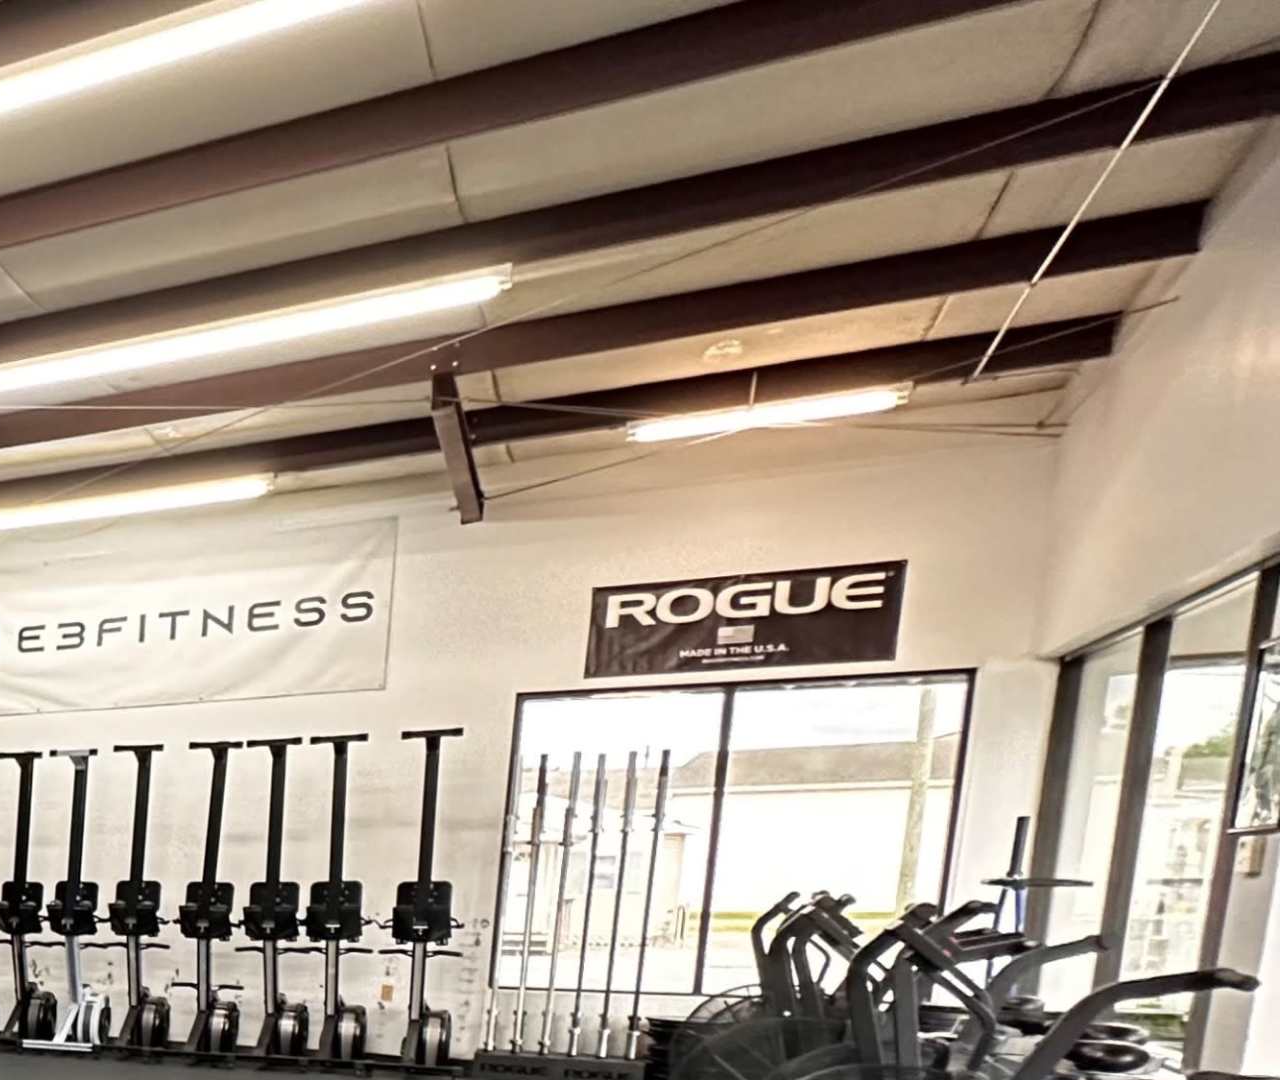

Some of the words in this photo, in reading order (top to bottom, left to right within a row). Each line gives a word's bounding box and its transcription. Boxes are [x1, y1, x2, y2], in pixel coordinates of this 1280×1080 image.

[17, 590, 375, 653] E3FITNESS
[605, 572, 886, 628] ROGUE
[679, 648, 712, 658] MADE
[714, 647, 727, 656] IN
[729, 646, 752, 654] THE
[753, 643, 790, 653] U.S.A.
